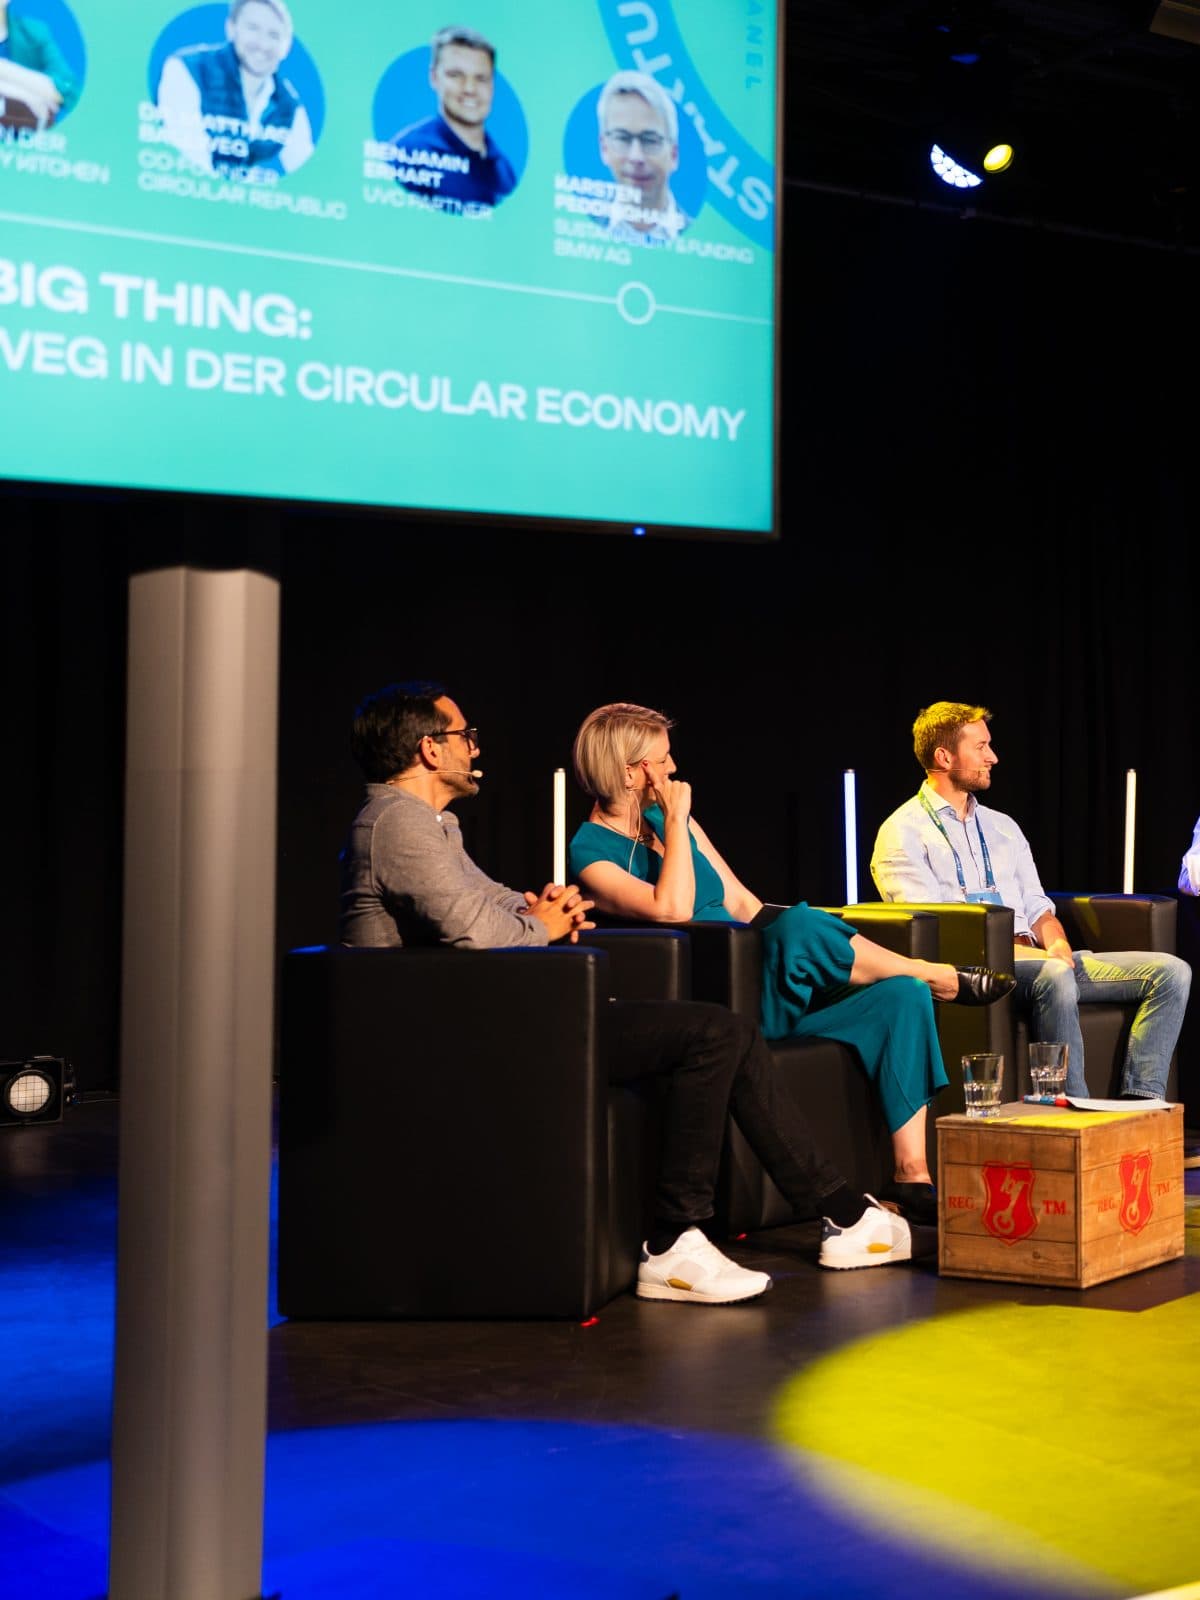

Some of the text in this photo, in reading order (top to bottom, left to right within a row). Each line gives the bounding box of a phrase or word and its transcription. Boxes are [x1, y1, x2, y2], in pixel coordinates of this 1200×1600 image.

[363, 139, 470, 174] BENJAMIN
[363, 159, 444, 188] ERHART
[138, 170, 347, 221] CIRCULAR REPUBLIC
[554, 174, 643, 204] KARSTEN
[98, 270, 313, 342] THING:
[120, 339, 174, 387] IN
[185, 347, 287, 398] DER
[296, 361, 526, 421] CIRCULAR
[535, 386, 746, 442] ECONOMY
